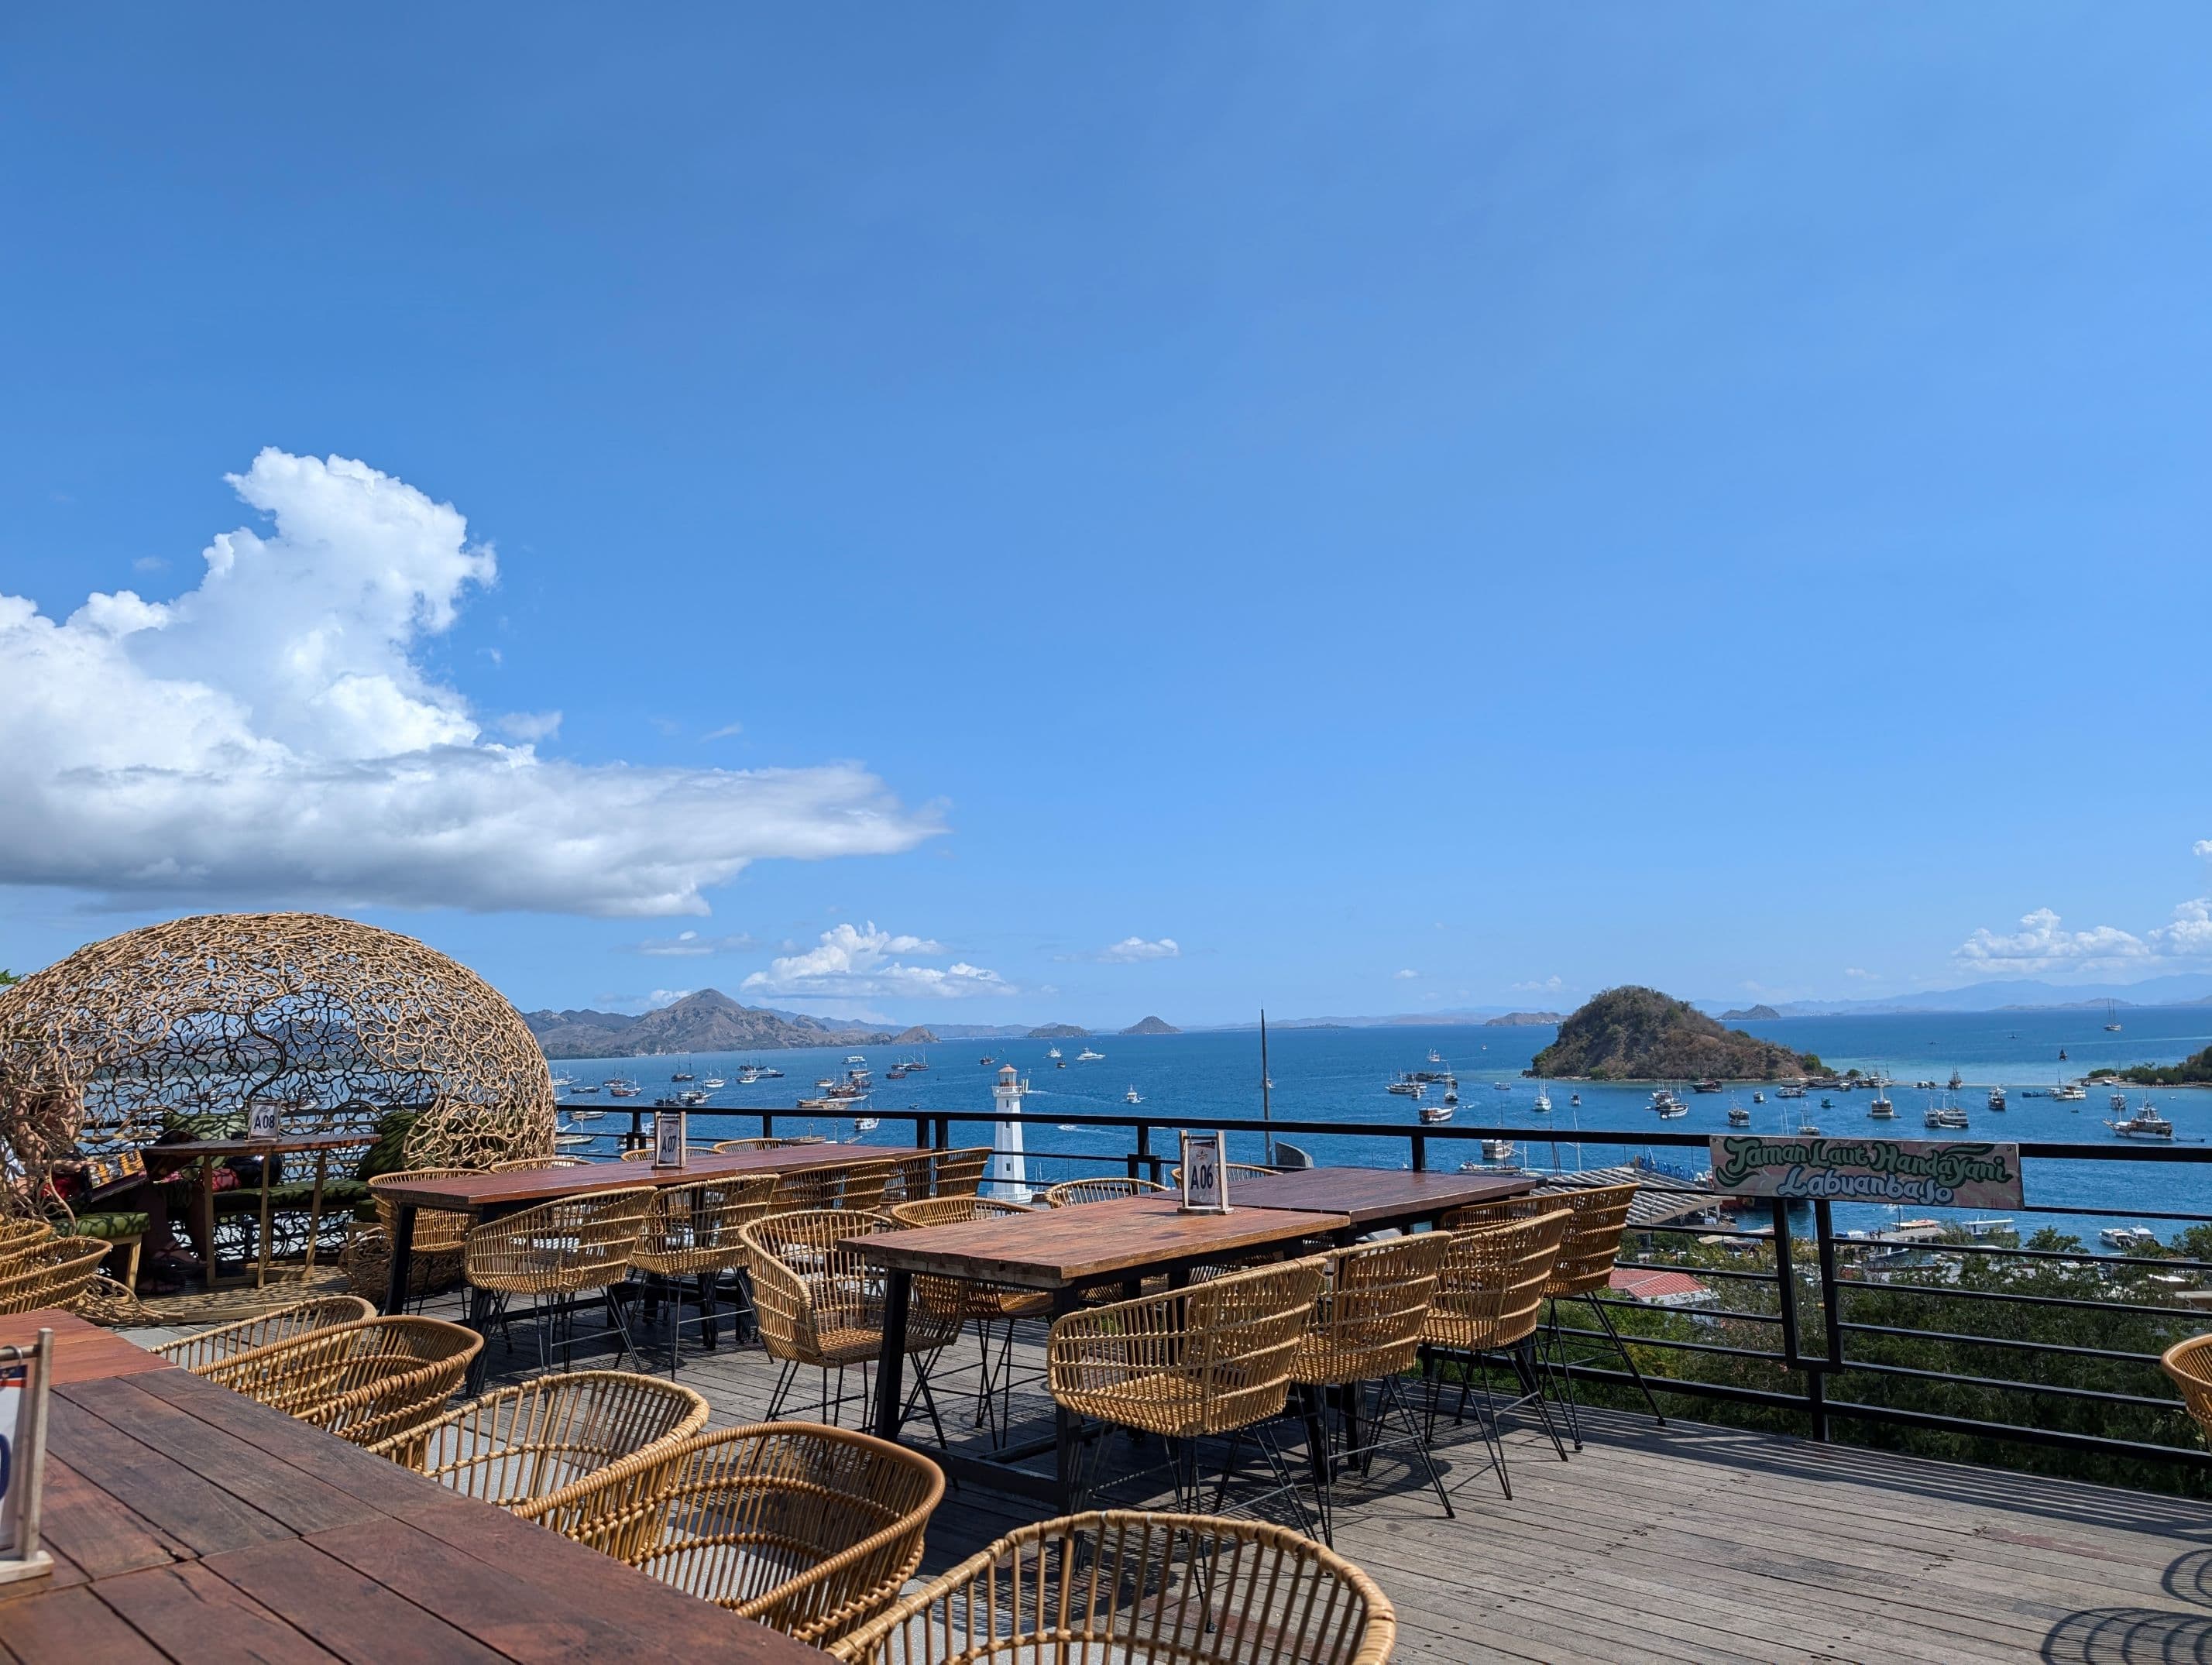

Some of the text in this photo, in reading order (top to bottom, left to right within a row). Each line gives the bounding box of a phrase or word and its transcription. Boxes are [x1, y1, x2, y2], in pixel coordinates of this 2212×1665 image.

[253, 1115, 275, 1129] A08
[661, 1135, 677, 1153] A07
[1723, 1137, 1809, 1176] Taman
[1808, 1139, 1871, 1169] Laut
[1190, 1162, 1214, 1190] A06
